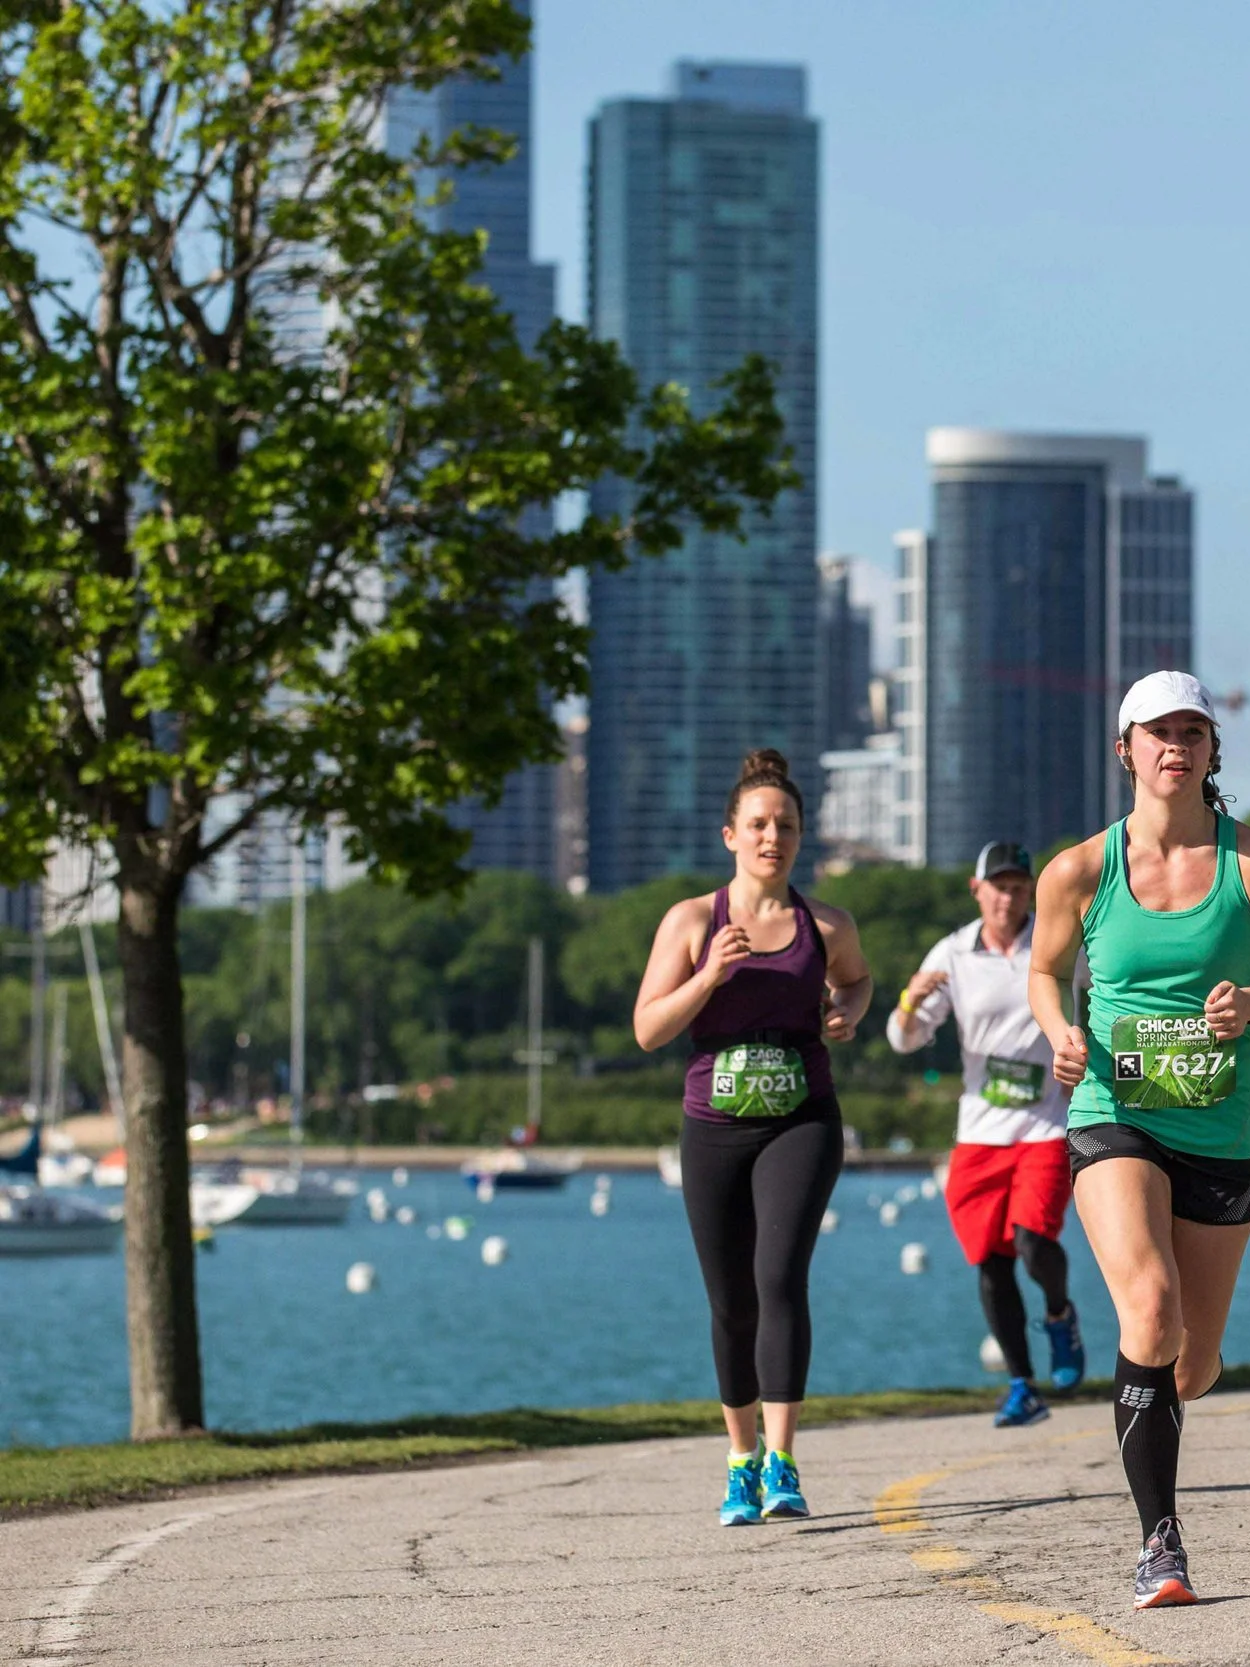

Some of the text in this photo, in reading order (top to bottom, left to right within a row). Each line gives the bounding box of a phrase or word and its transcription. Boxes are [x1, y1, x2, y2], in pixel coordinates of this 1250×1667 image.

[1136, 1018, 1209, 1032] CHICAGO
[1136, 1032, 1177, 1043] SPRING
[1155, 1052, 1223, 1076] 7627
[745, 1073, 796, 1094] 7021
[1119, 1398, 1151, 1409] cep
